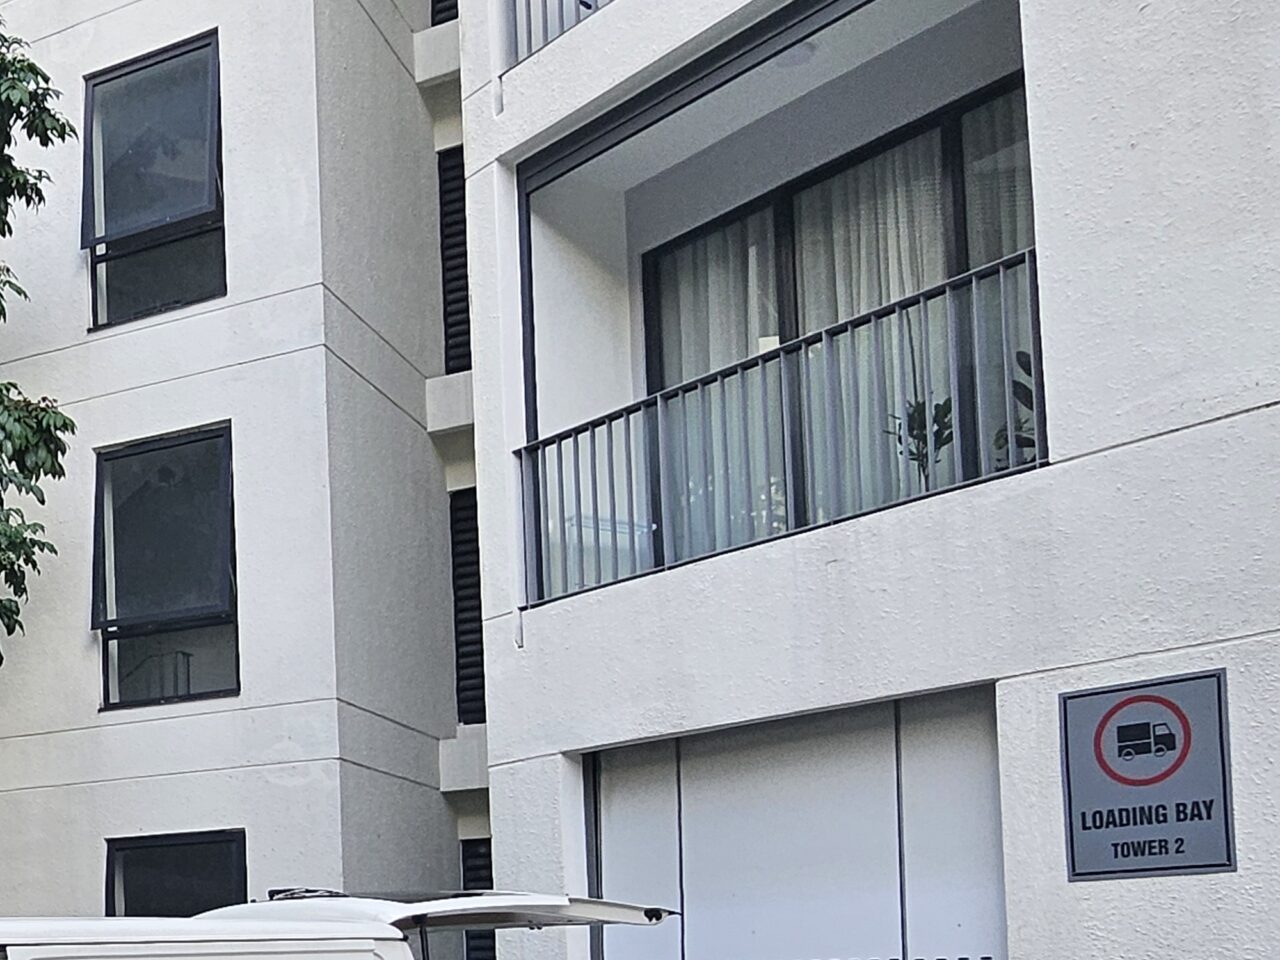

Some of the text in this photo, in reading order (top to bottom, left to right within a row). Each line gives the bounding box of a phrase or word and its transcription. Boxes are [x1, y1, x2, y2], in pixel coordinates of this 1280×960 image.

[1081, 799, 1214, 831] LOADING BAY
[1111, 838, 1185, 859] TOWER 2
